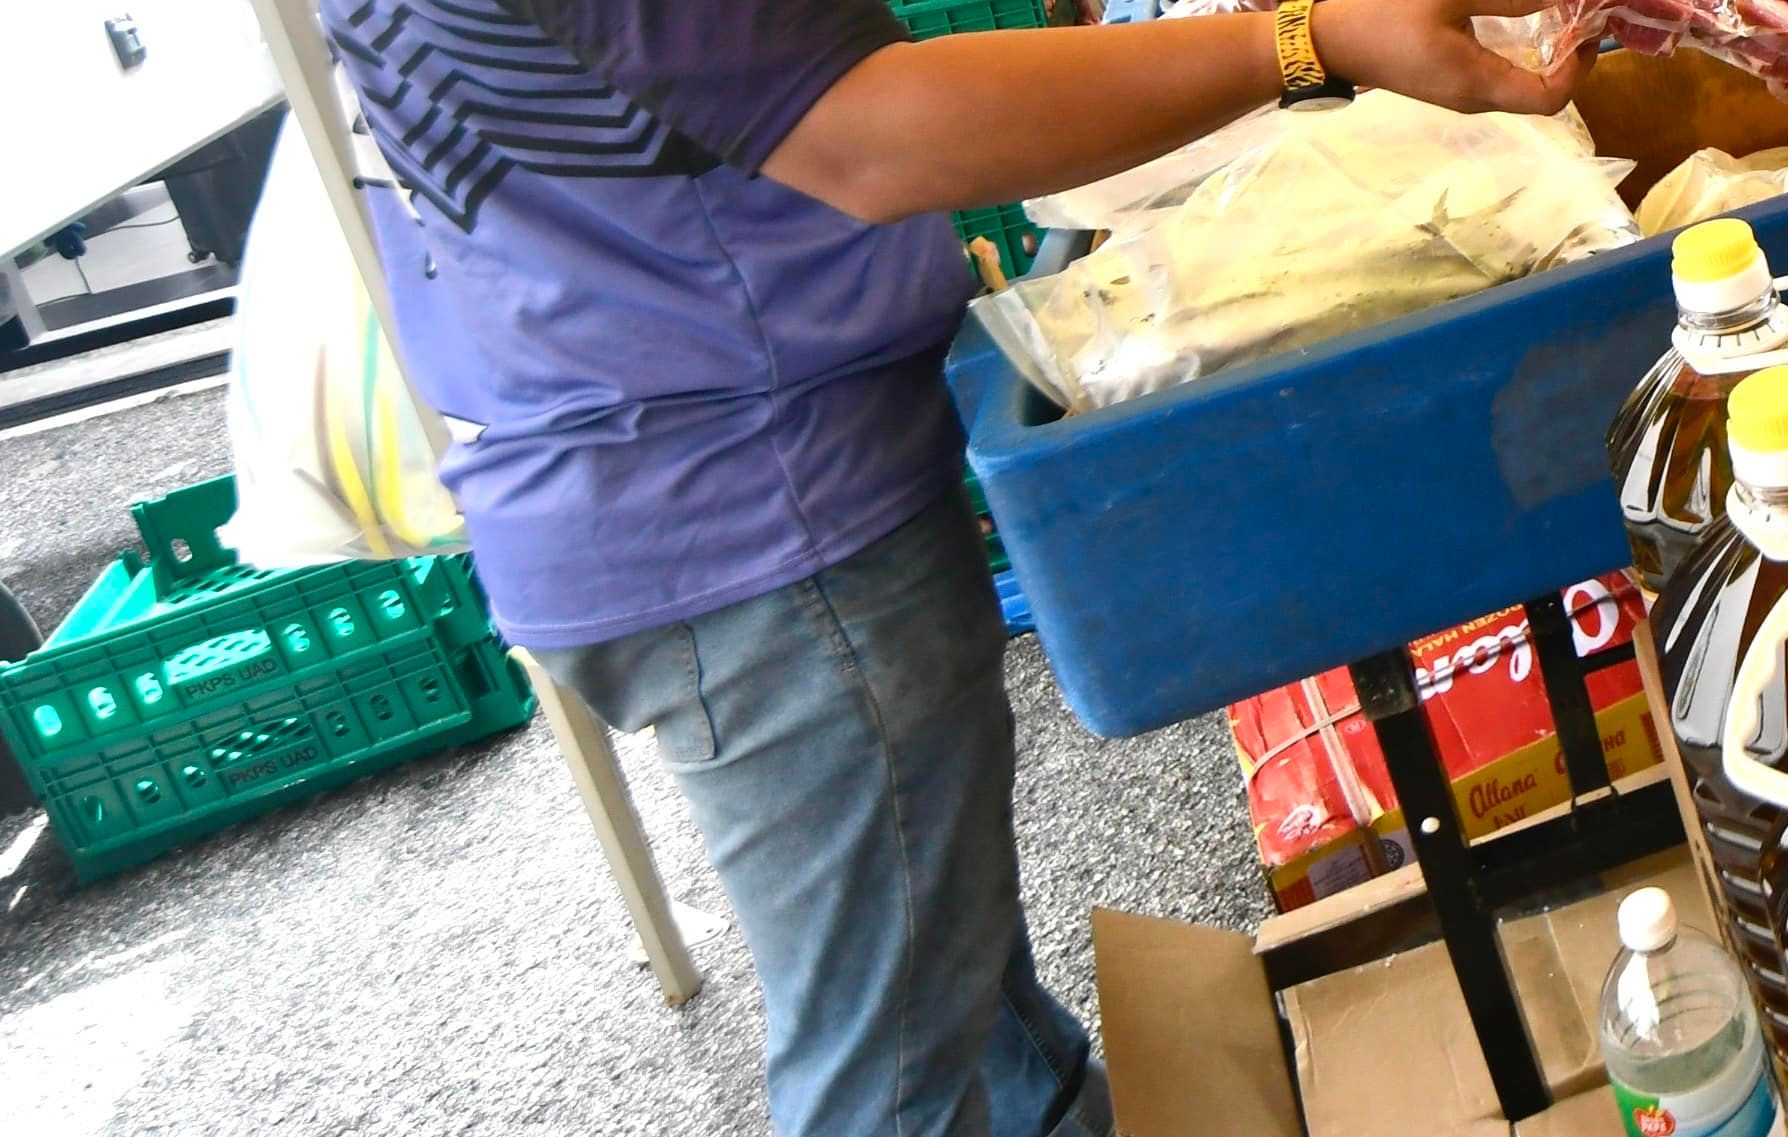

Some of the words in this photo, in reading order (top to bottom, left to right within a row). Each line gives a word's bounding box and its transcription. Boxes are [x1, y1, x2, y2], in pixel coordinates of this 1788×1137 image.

[185, 674, 236, 698] PKPS
[239, 658, 277, 679] UAD
[229, 762, 277, 785] PKPS
[280, 747, 318, 770] UAD
[1469, 772, 1538, 819] Allana
